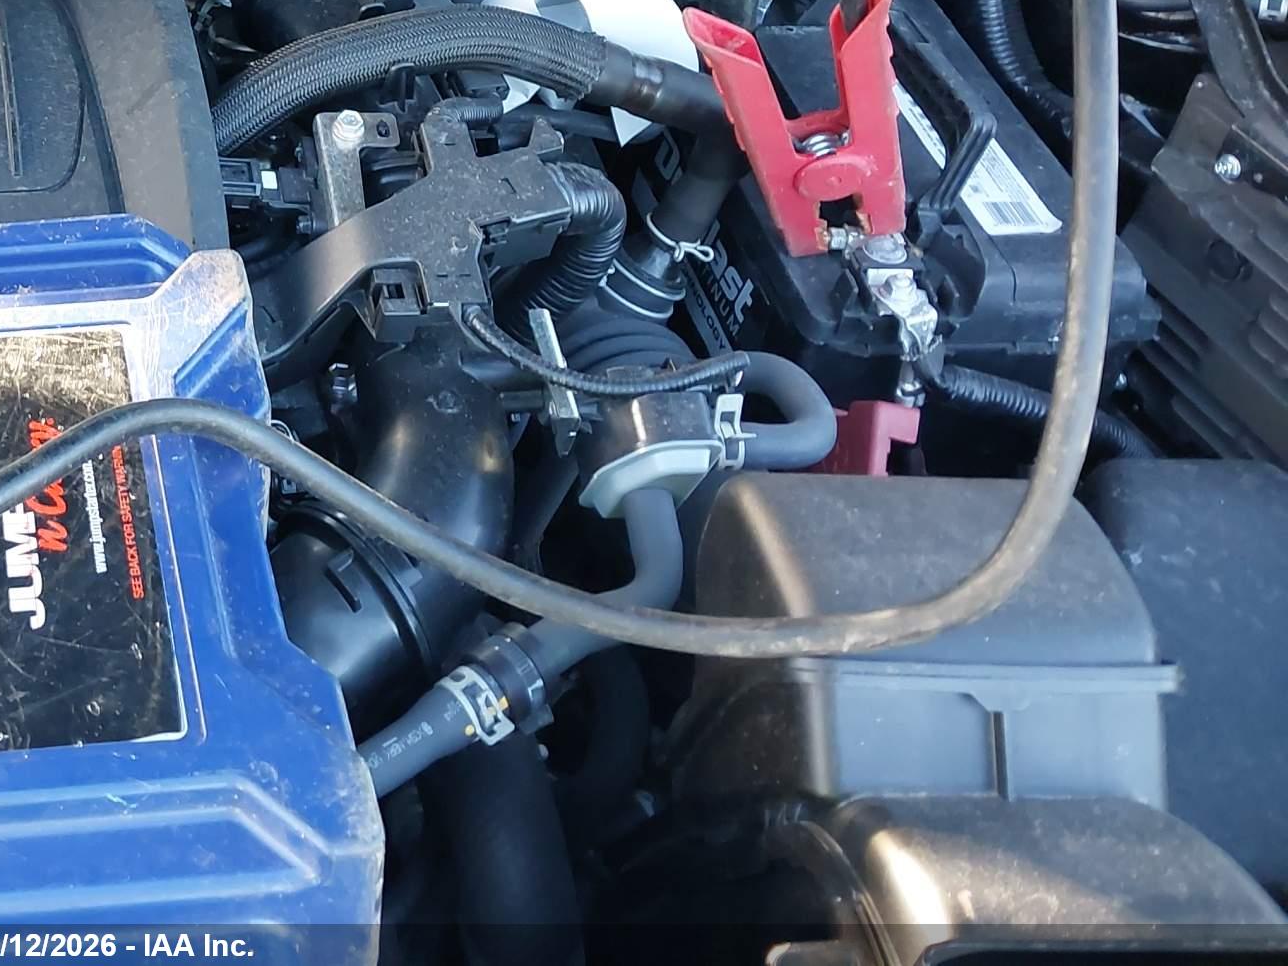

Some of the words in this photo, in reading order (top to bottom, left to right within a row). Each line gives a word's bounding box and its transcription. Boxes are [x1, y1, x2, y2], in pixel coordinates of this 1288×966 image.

[112, 445, 126, 483] WARNIN
[117, 485, 133, 522] SAFETY
[122, 523, 136, 546] FOR
[126, 546, 142, 576] BACK
[130, 576, 145, 599] SEE
